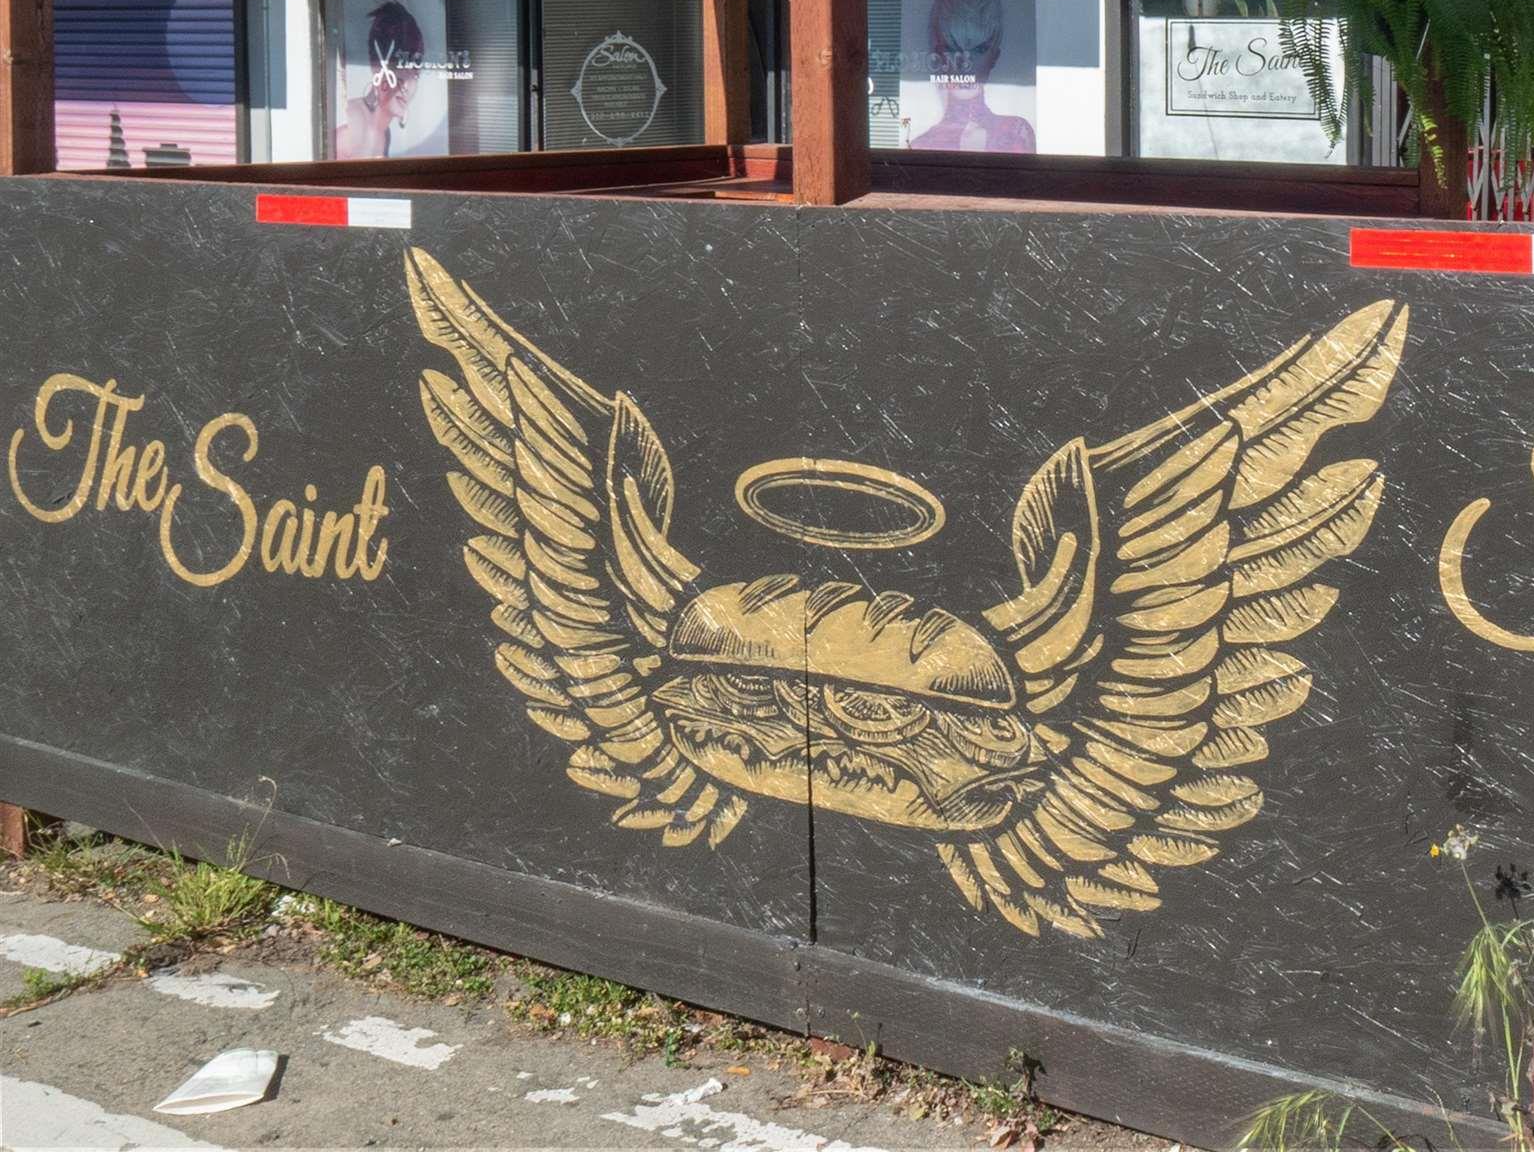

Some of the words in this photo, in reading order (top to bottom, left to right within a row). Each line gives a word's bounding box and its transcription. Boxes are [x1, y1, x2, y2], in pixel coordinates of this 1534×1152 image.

[1177, 45, 1230, 81] The
[930, 74, 949, 83] HAIR
[950, 74, 976, 83] SALON
[1251, 92, 1267, 101] and
[9, 373, 168, 523] The
[160, 412, 390, 587] Saint
